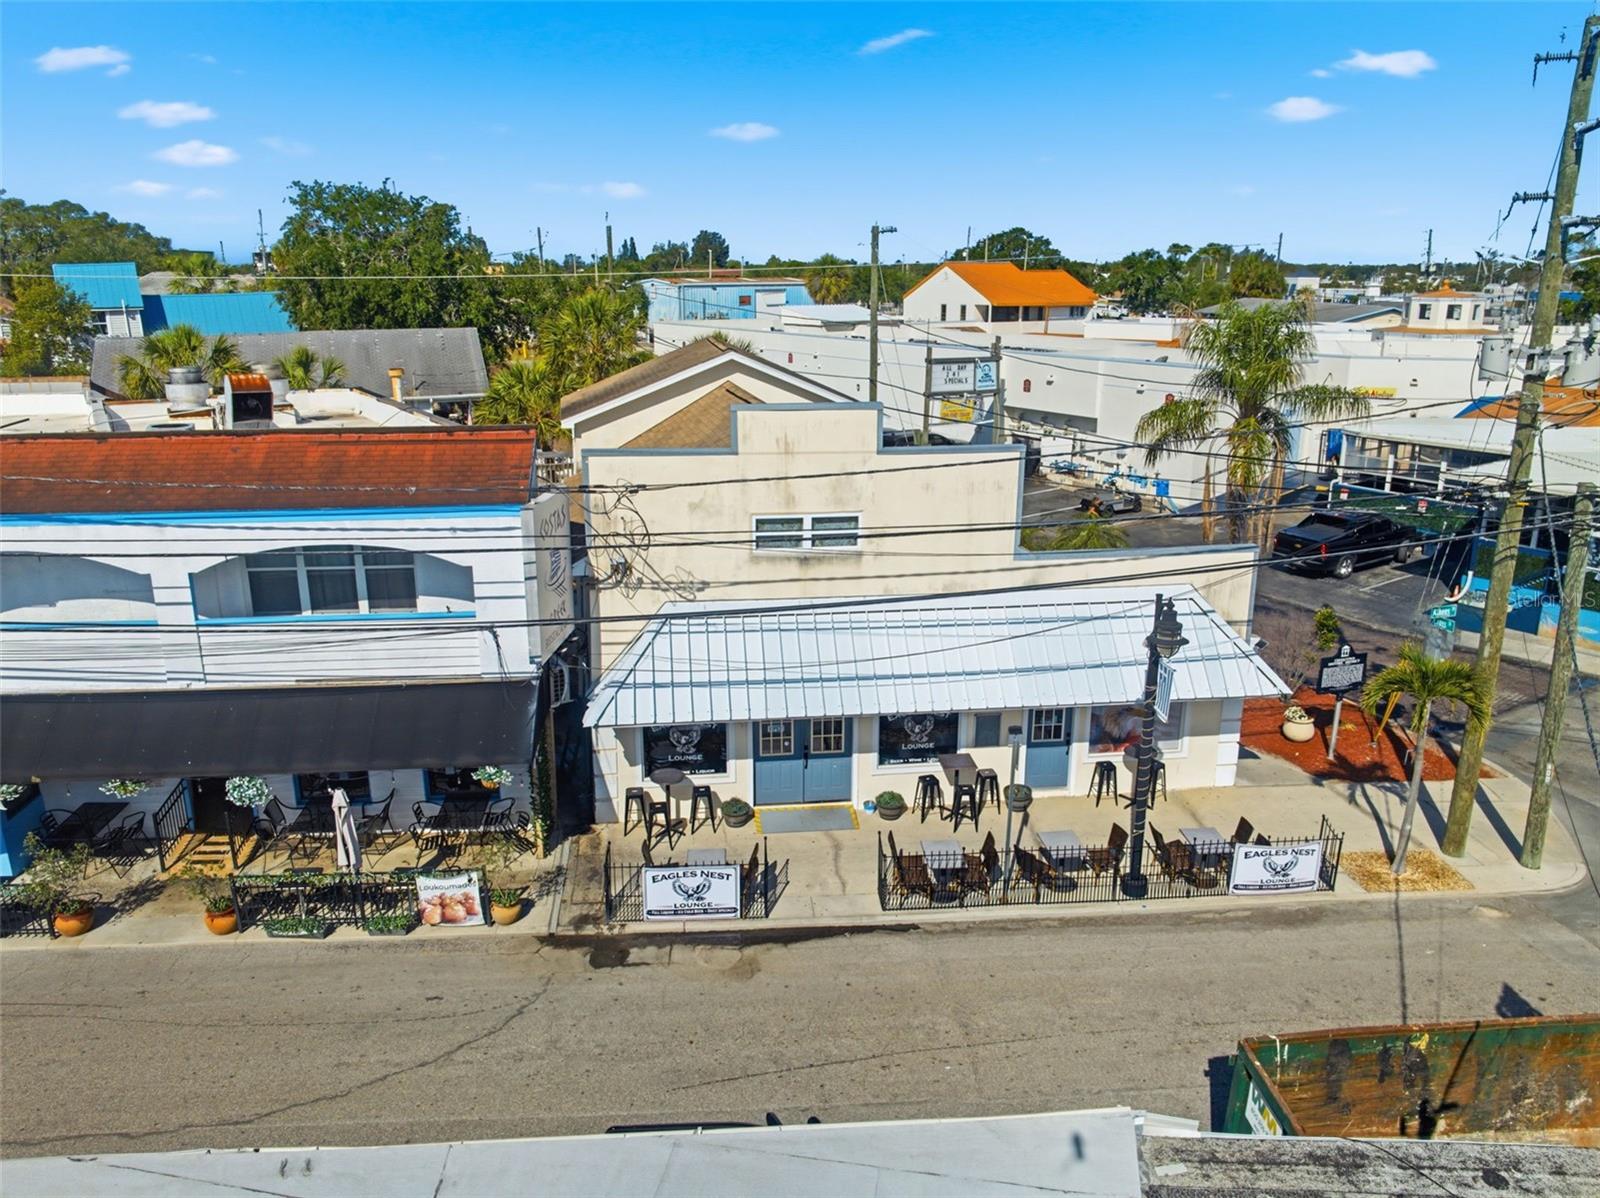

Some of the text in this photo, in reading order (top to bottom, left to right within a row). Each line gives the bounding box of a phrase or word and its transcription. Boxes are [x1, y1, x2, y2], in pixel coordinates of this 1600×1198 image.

[539, 503, 566, 541] COSTAS
[902, 742, 935, 750] LOUNGE
[668, 753, 704, 761] LOUNGE
[1244, 848, 1316, 860] EAGLES NEST
[651, 870, 732, 884] EAGLES NEST
